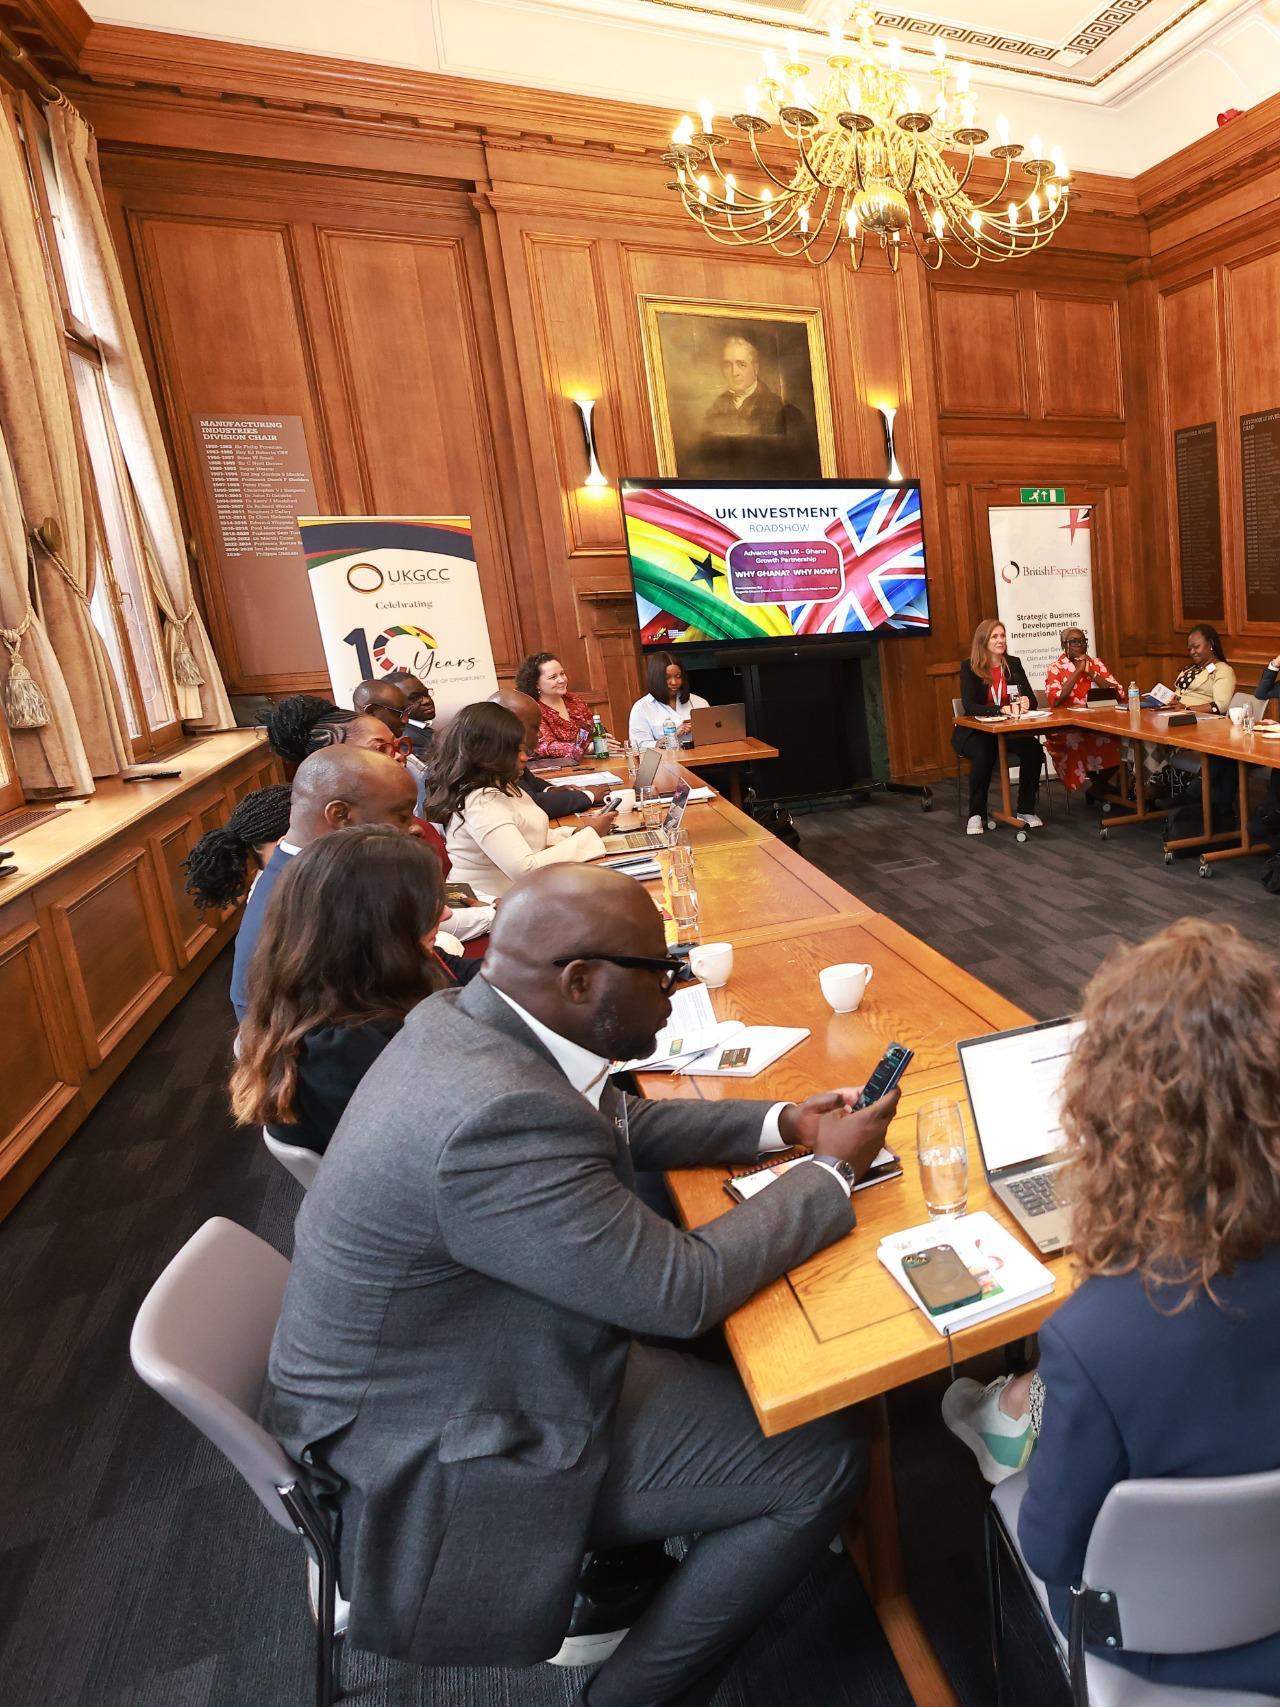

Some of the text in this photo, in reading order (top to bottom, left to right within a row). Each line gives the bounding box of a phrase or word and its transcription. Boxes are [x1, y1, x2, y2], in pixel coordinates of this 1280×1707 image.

[716, 507, 838, 519] UK INVESTMENT
[749, 524, 810, 533] ROADSHOW
[388, 568, 450, 582] UKGCC
[375, 601, 433, 609] Celebrating
[1017, 613, 1047, 621] Strategic
[1022, 620, 1069, 629] Development
[1011, 630, 1057, 639] International
[413, 651, 479, 679] Years
